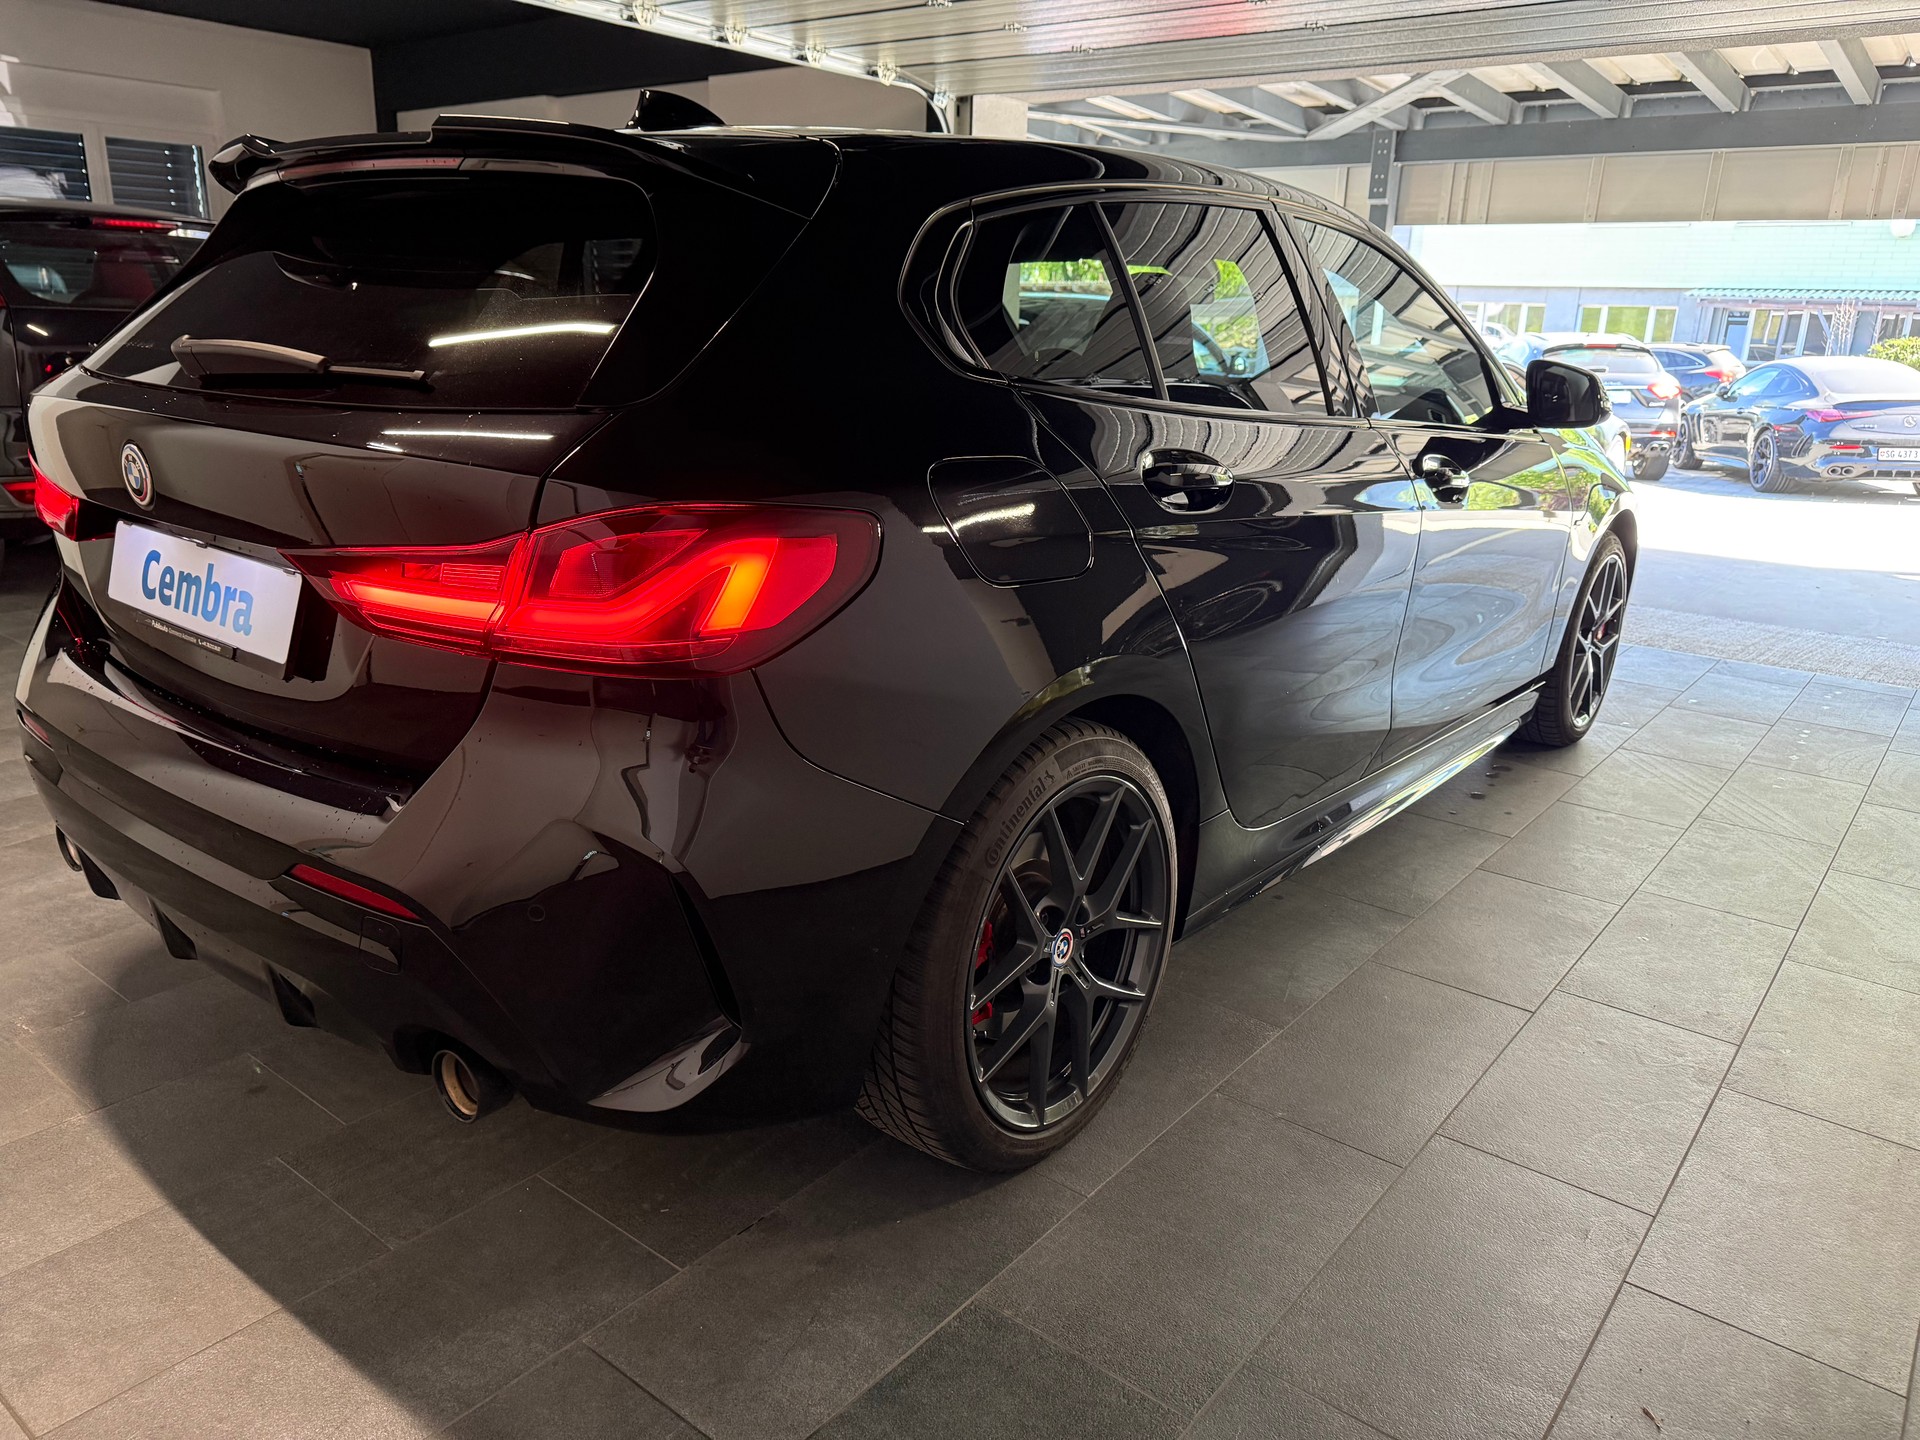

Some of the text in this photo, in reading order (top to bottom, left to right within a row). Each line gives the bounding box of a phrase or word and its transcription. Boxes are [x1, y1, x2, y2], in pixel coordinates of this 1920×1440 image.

[1885, 450, 1895, 459] SG
[142, 550, 254, 636] Cembra
[985, 776, 1048, 865] Continental
